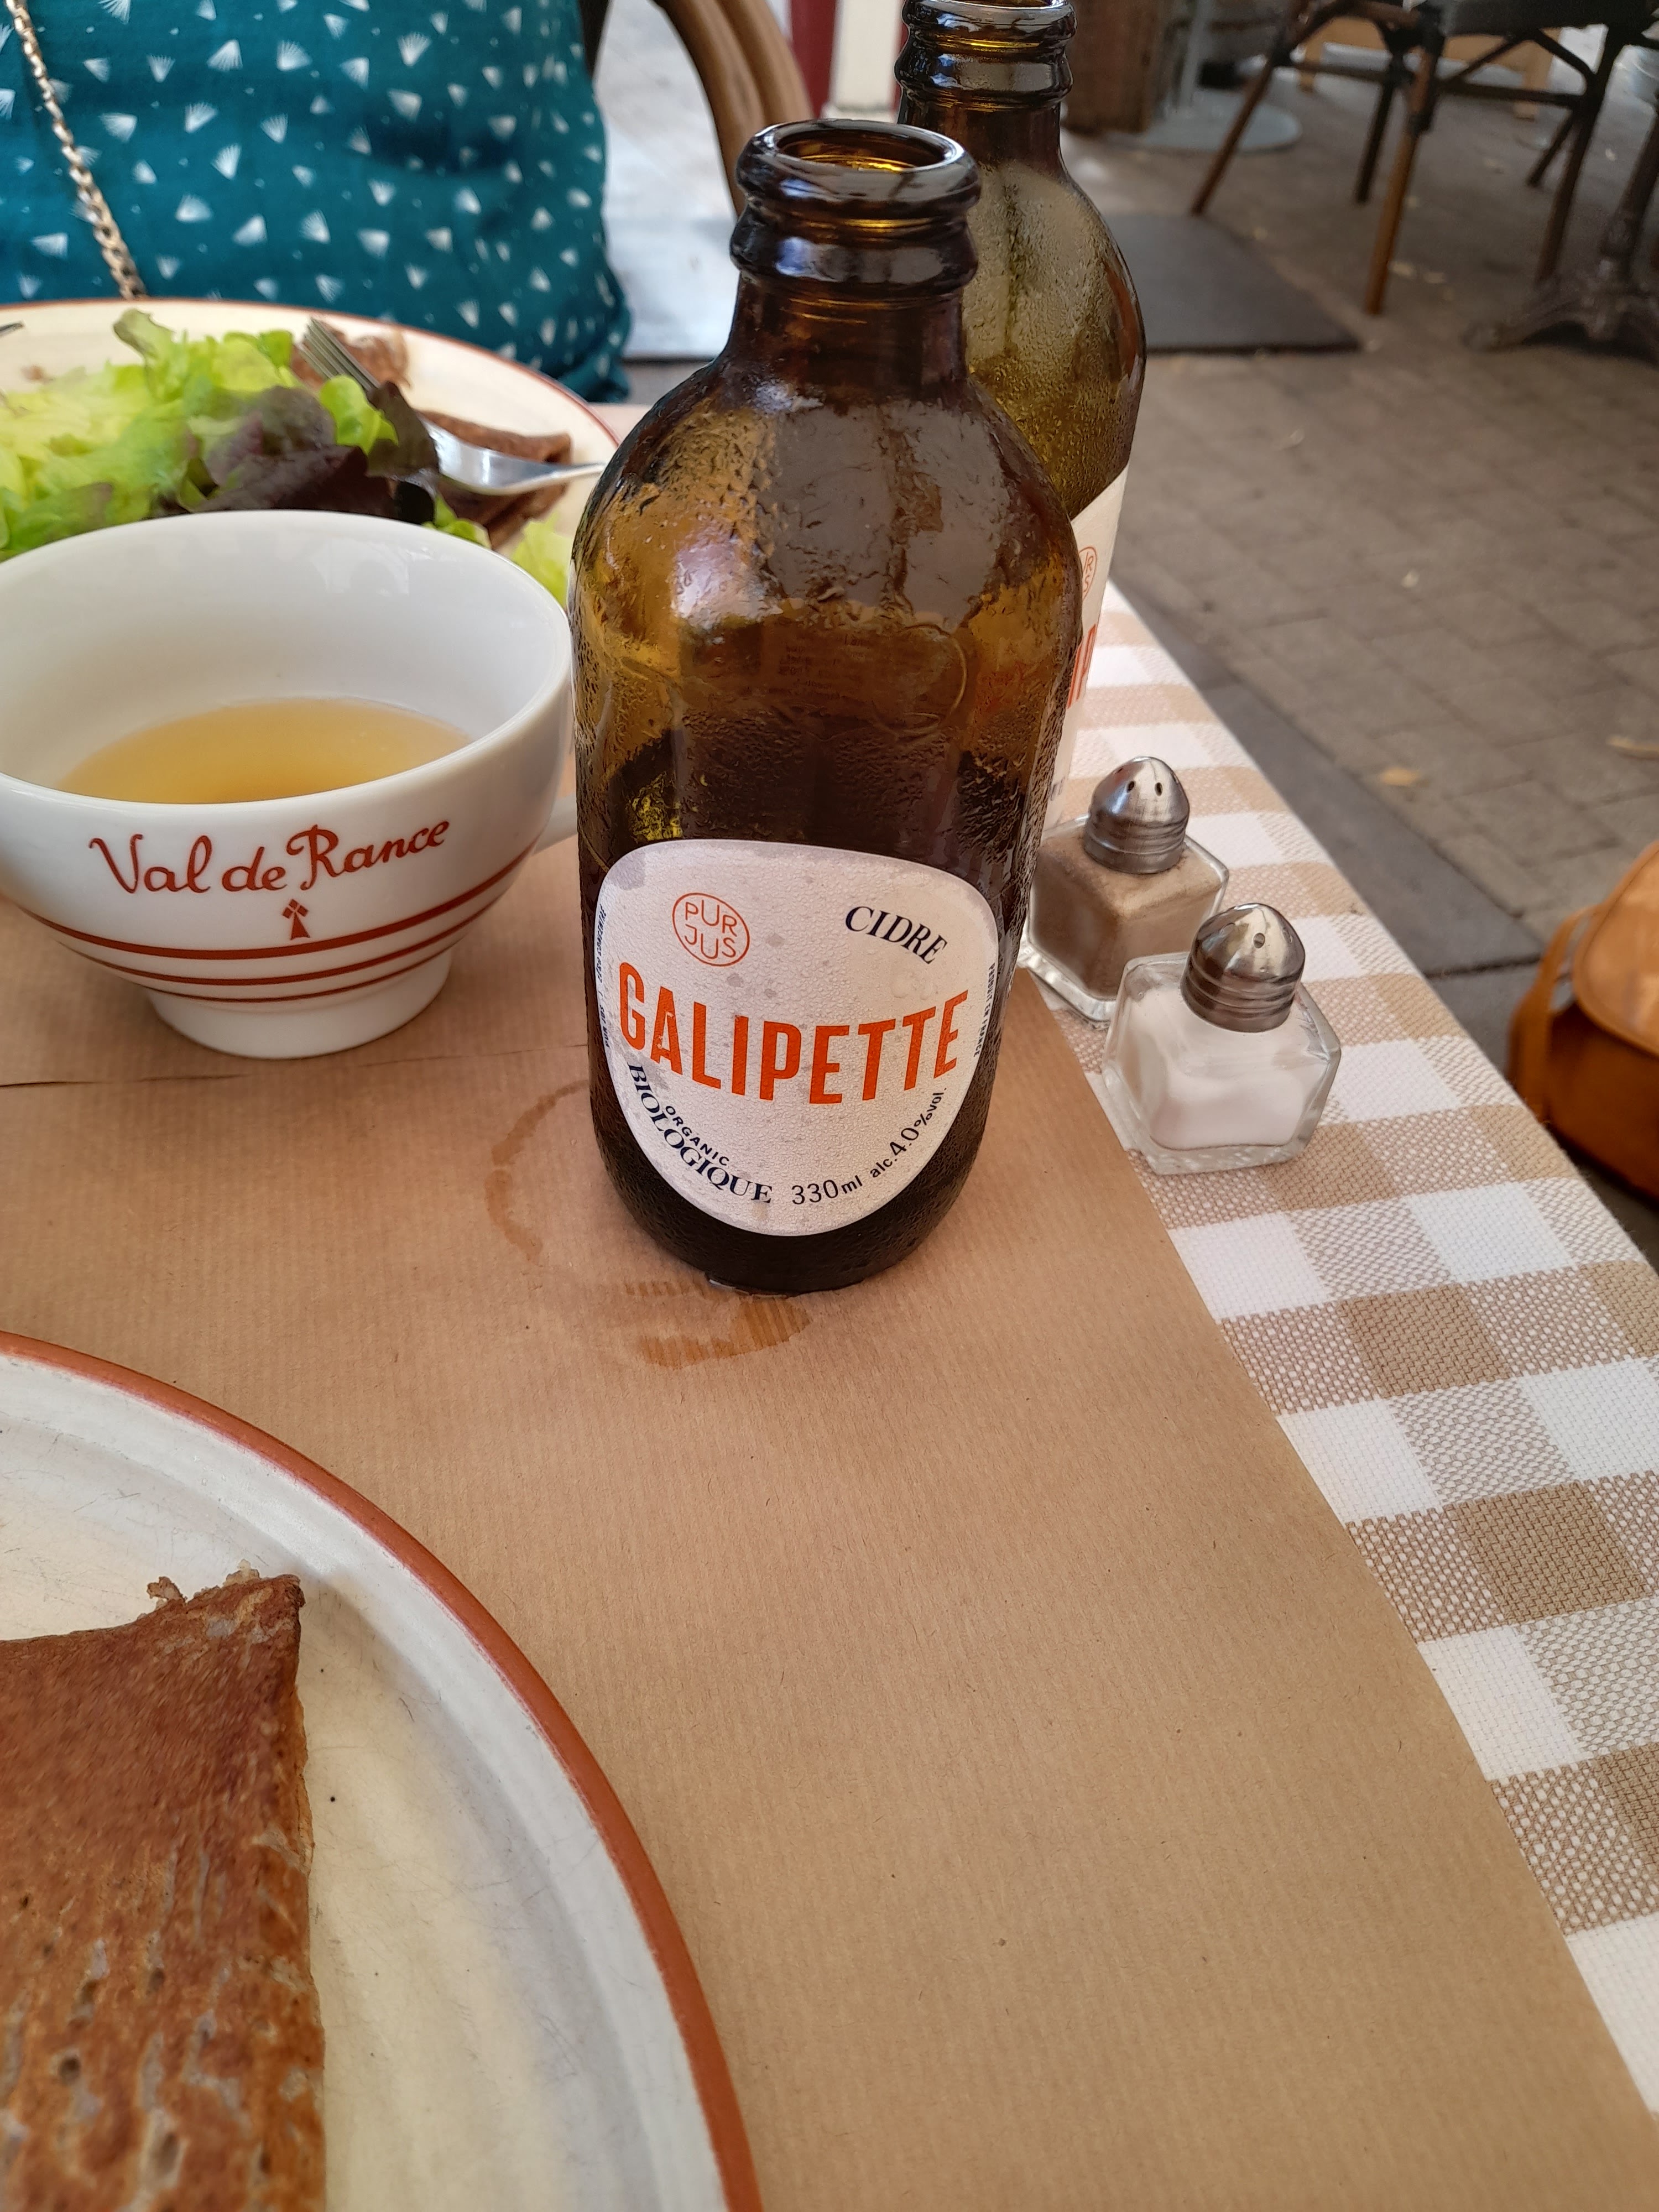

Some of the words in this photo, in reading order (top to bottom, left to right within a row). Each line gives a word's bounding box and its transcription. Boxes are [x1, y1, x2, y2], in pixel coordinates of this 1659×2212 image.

[88, 834, 213, 894] Val
[221, 846, 288, 892] de
[286, 820, 450, 891] Rance
[684, 924, 737, 960] JUS
[685, 899, 738, 937] PUR
[845, 905, 948, 964] CIDRE
[619, 962, 968, 1104] GALIPETTE
[627, 1062, 773, 1204] BIOLOGIQUE
[665, 1105, 730, 1166] ORGANIC
[791, 1175, 863, 1205] 330ml
